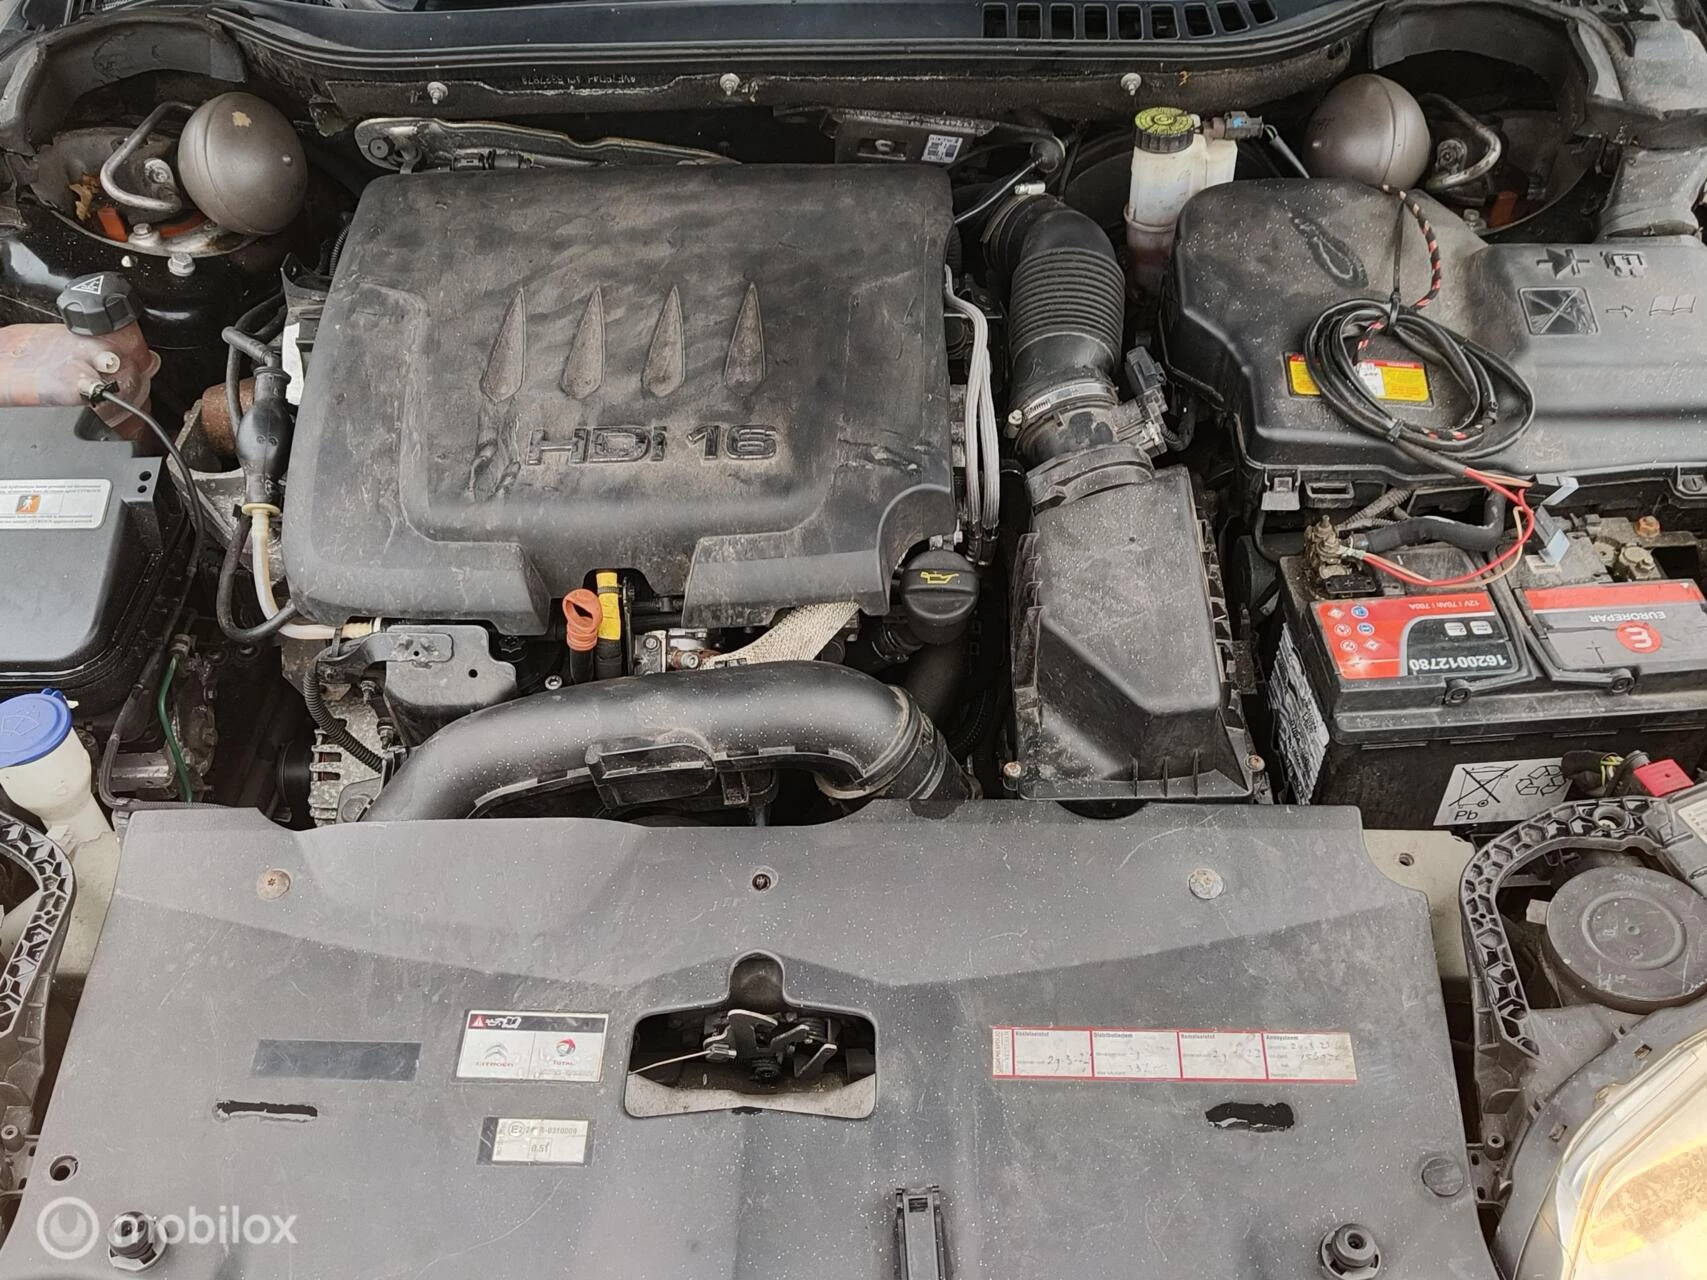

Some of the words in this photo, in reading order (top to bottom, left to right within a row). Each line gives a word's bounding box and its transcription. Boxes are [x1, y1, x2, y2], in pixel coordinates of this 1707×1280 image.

[686, 424, 778, 461] 16
[1463, 599, 1480, 607] 12V
[1589, 611, 1667, 623] EUROREPAR
[1409, 653, 1507, 671] 1620012780
[1453, 810, 1478, 822] Pb
